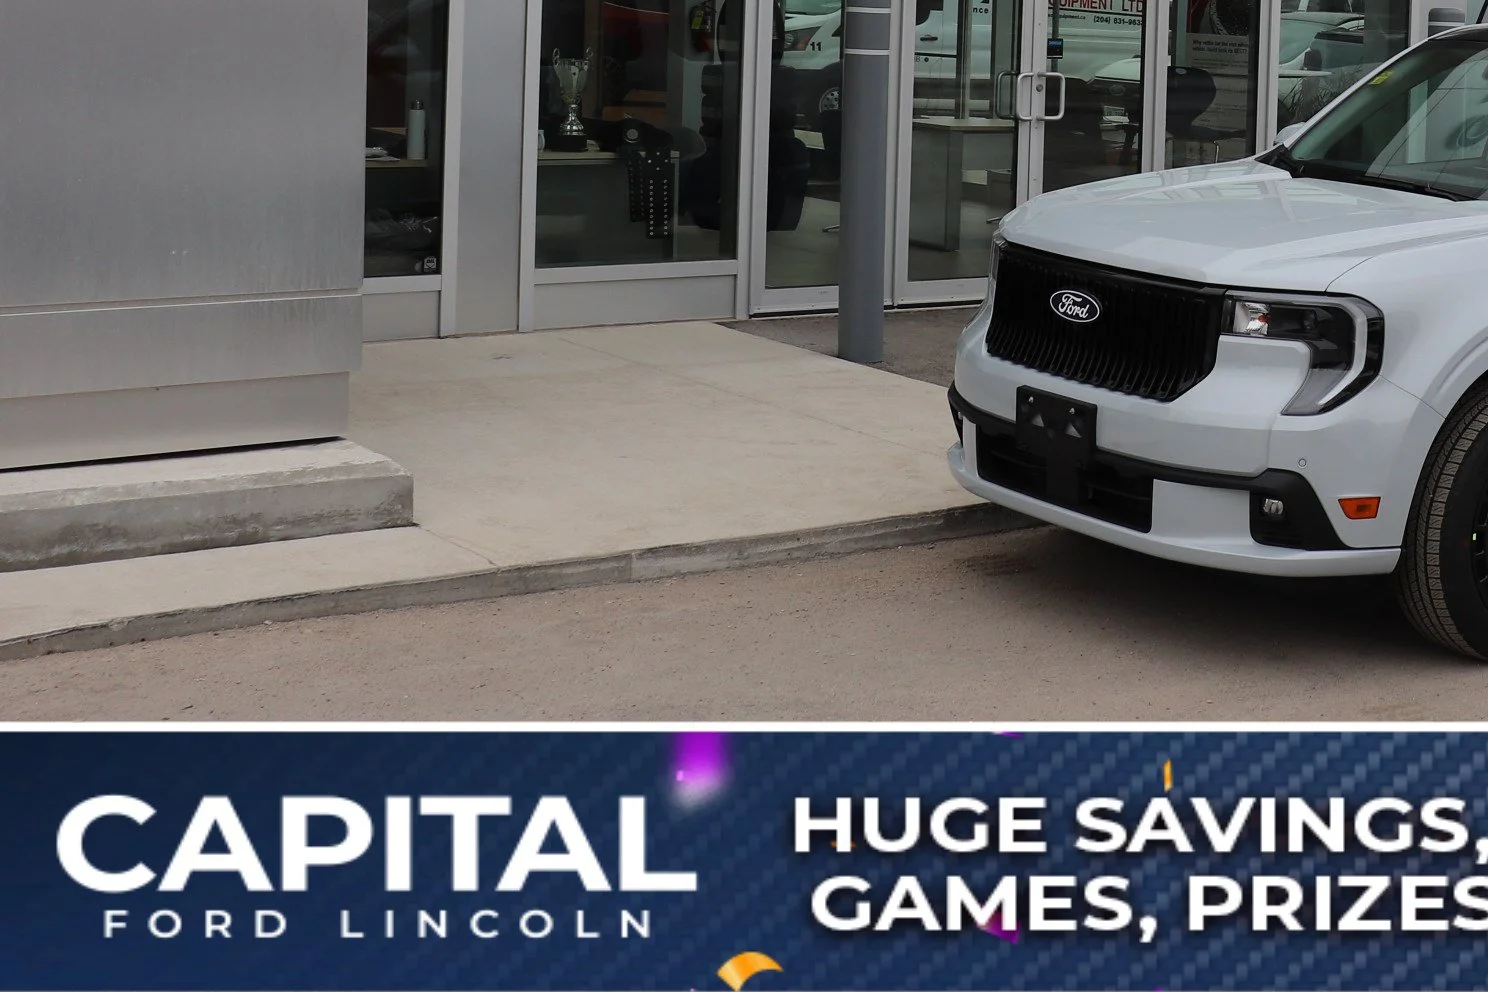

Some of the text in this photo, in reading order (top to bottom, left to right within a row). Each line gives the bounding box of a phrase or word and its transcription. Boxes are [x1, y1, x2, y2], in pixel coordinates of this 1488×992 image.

[1093, 15, 1111, 25] (204)
[810, 41, 822, 52] 11
[1058, 293, 1089, 319] Ford
